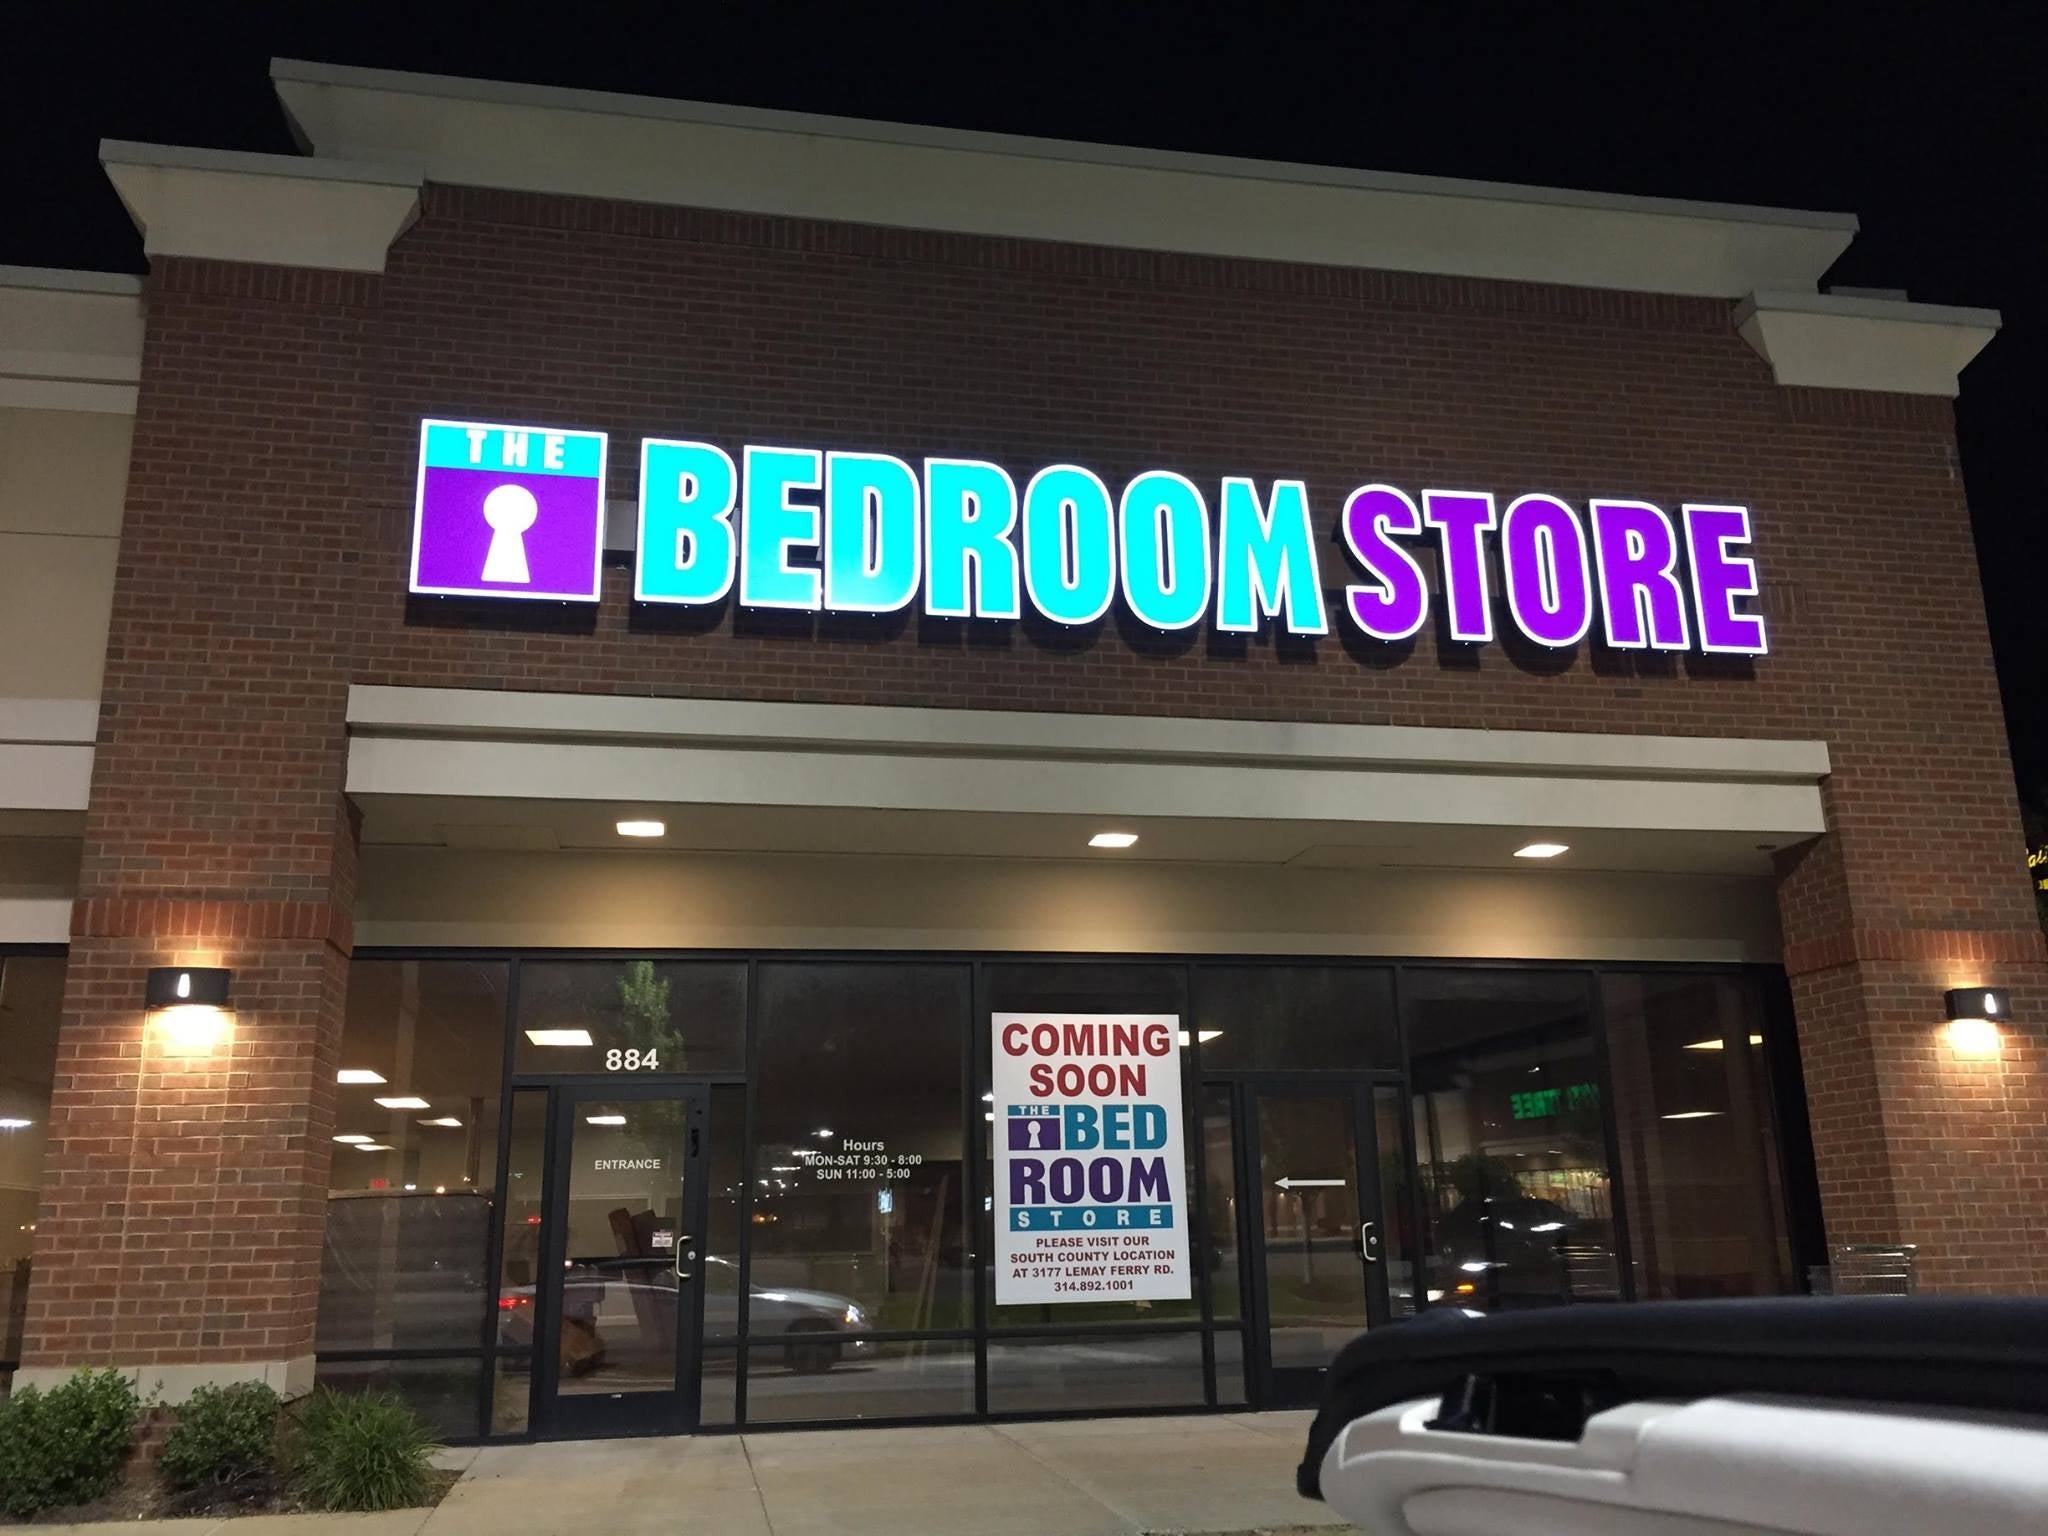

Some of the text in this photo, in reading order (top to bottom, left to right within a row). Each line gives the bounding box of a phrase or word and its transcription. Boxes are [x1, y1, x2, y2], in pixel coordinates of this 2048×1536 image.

[465, 428, 567, 471] THE
[634, 436, 1768, 656] BEDROOM STORE
[1002, 1023, 1171, 1057] COMING
[605, 1048, 660, 1071] 884
[1029, 1063, 1148, 1098] SOON
[1018, 1105, 1050, 1116] THE
[1063, 1104, 1168, 1151] BED
[843, 1139, 885, 1151] Hours
[594, 1159, 661, 1170] ENTRANCE
[804, 1155, 861, 1166] MON-SAT
[863, 1154, 888, 1166] 9:30
[816, 1168, 842, 1180] SUN
[846, 1168, 876, 1179] 11:00
[886, 1168, 911, 1179] 5:00
[1009, 1157, 1171, 1204] ROOM
[1018, 1209, 1162, 1228] STORE
[1036, 1236, 1150, 1248] PLEASE VISIT OUR
[1010, 1250, 1175, 1264] SOUTH COUNTY LOCATION
[1012, 1264, 1174, 1278] AT 3177 LEMAY FERRY RD.
[1054, 1280, 1134, 1292] 314.892.1001
